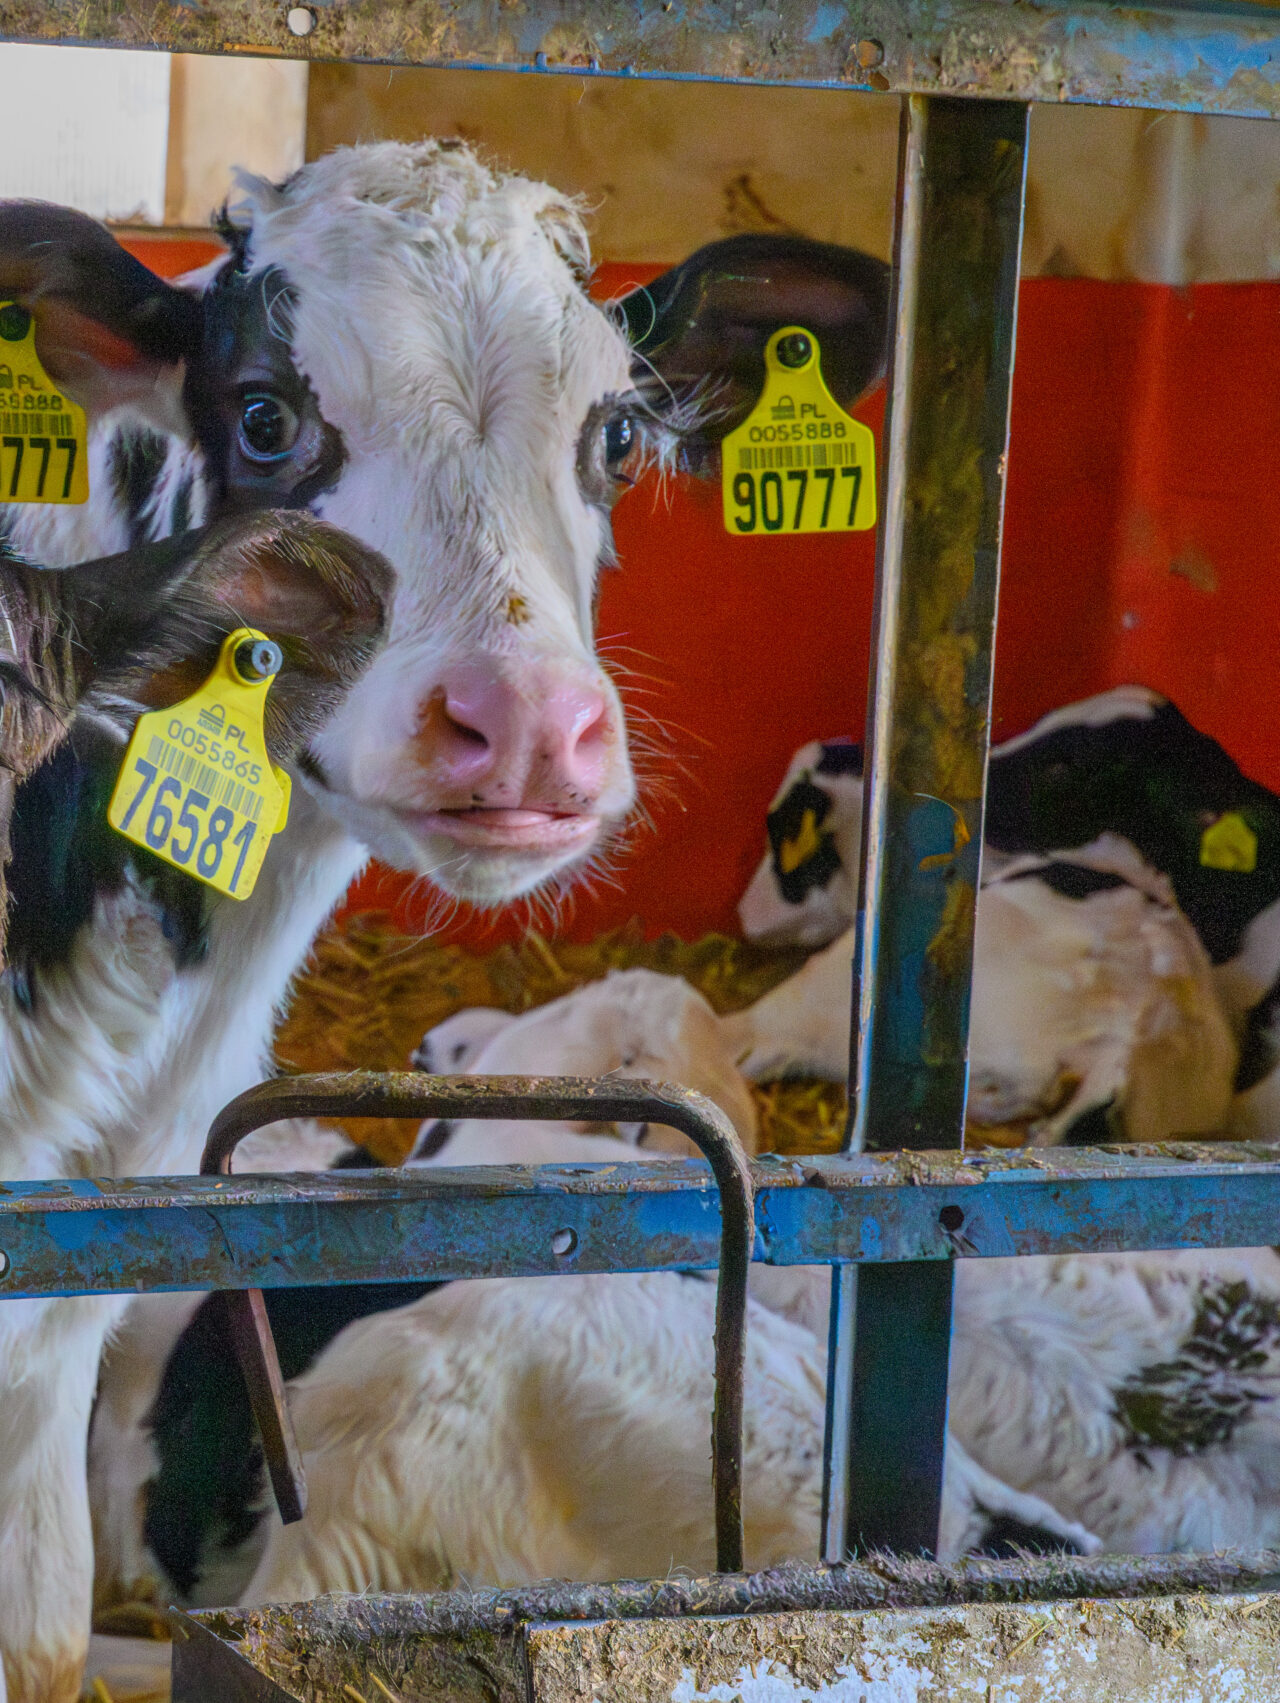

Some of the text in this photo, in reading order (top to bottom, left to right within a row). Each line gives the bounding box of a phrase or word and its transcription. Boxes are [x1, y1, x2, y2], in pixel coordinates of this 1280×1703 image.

[17, 374, 44, 391] PL
[800, 402, 826, 419] PL
[749, 421, 847, 442] 0055888
[733, 466, 862, 532] 90777
[167, 718, 263, 785] 0055865
[224, 724, 250, 754] PL
[119, 757, 258, 893] 76581
